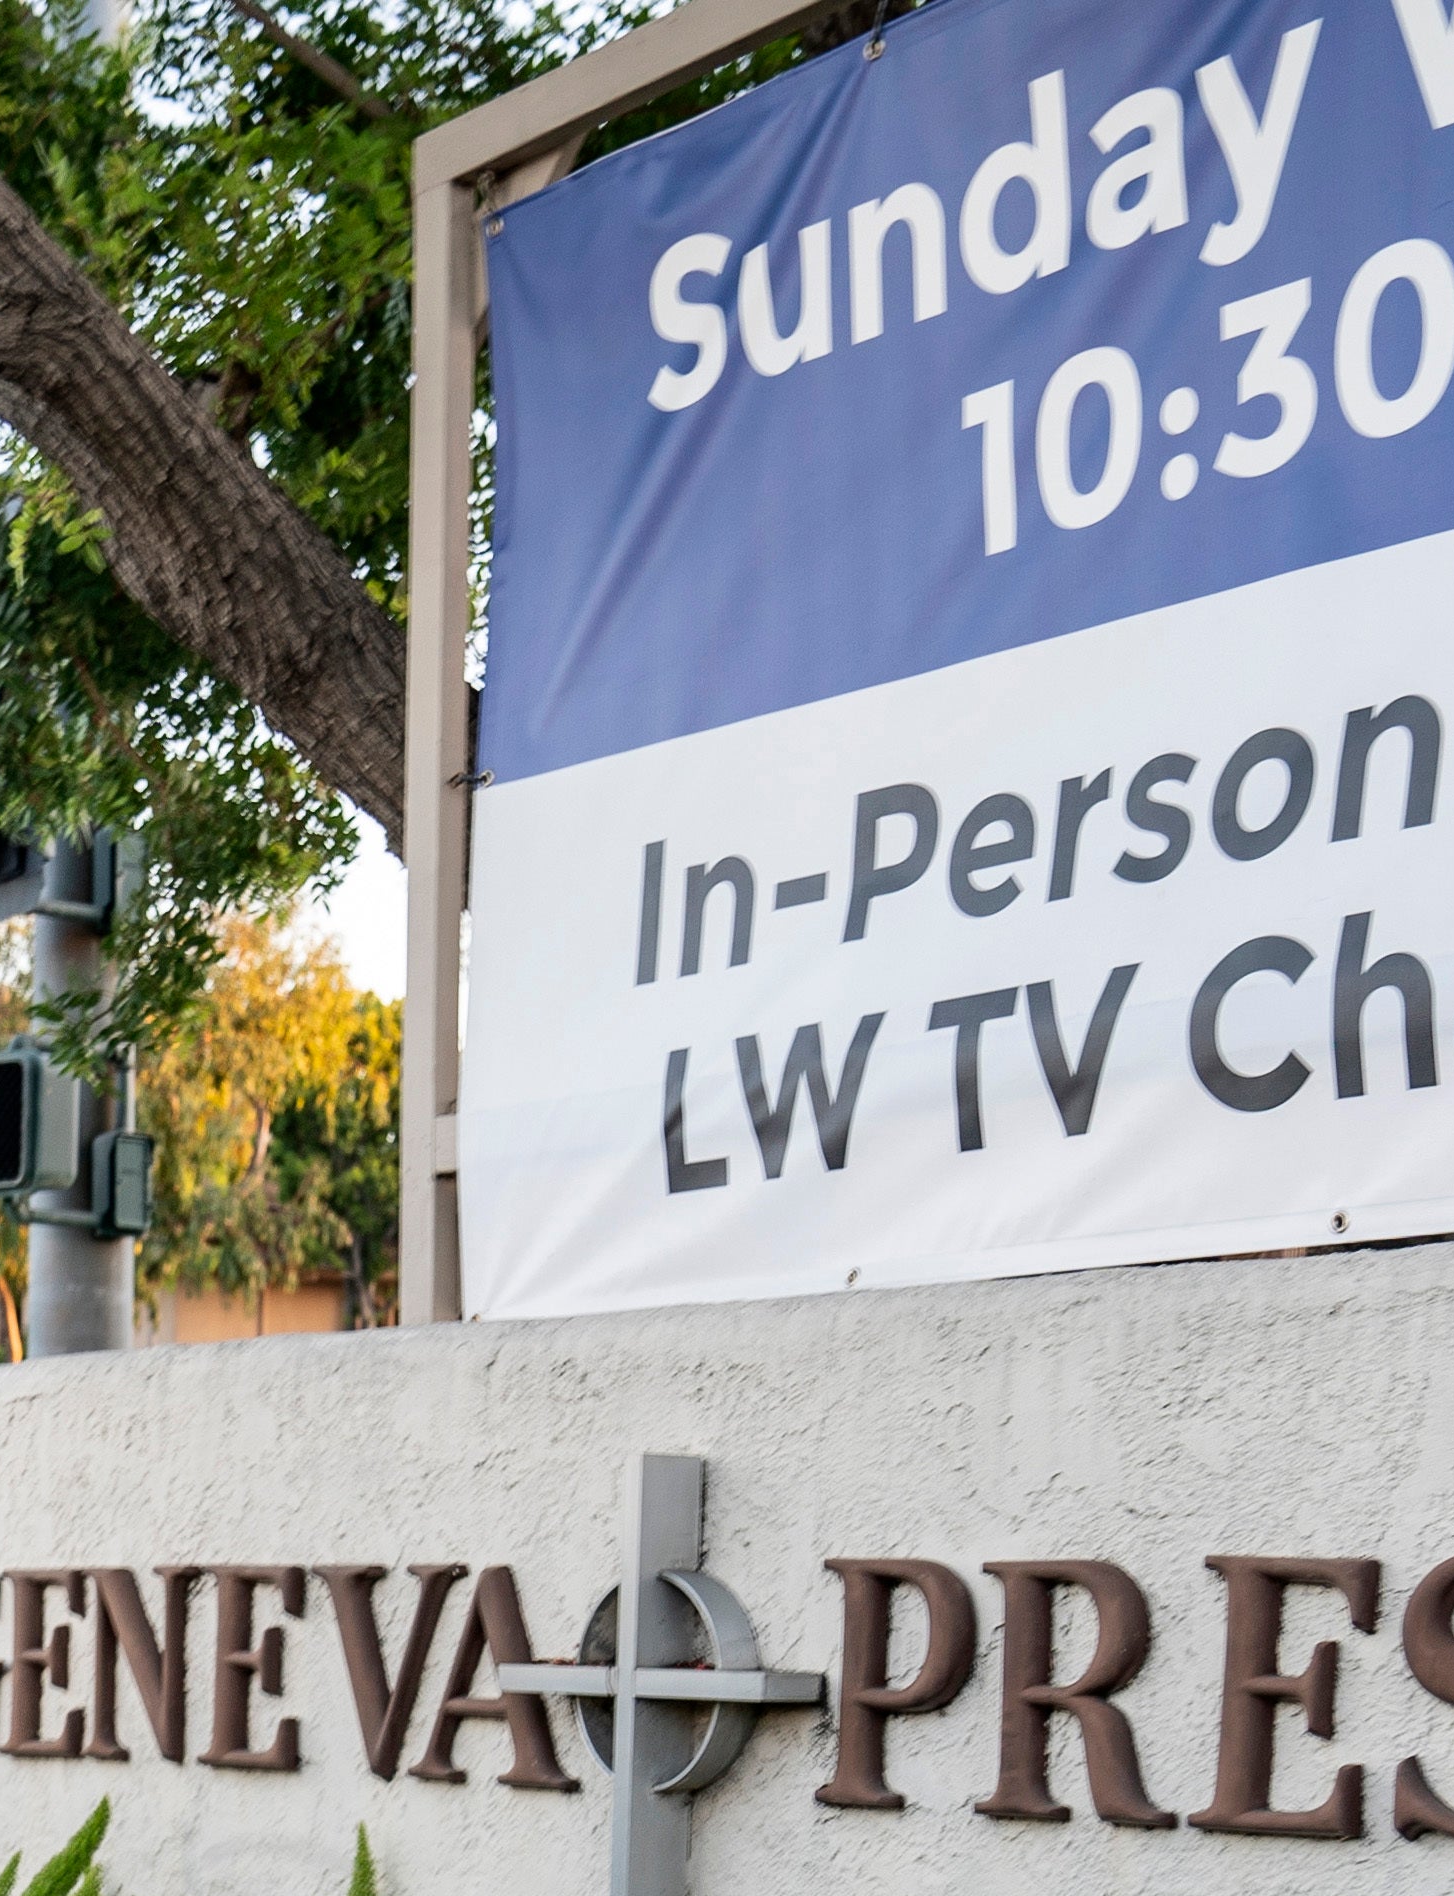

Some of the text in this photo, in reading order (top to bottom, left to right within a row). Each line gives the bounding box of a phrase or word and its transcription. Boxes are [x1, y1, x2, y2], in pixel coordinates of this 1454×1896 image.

[646, 16, 1324, 413] Sunday
[635, 693, 1443, 986] In-Person
[663, 1010, 887, 1194] LW
[926, 962, 1140, 1153] TV
